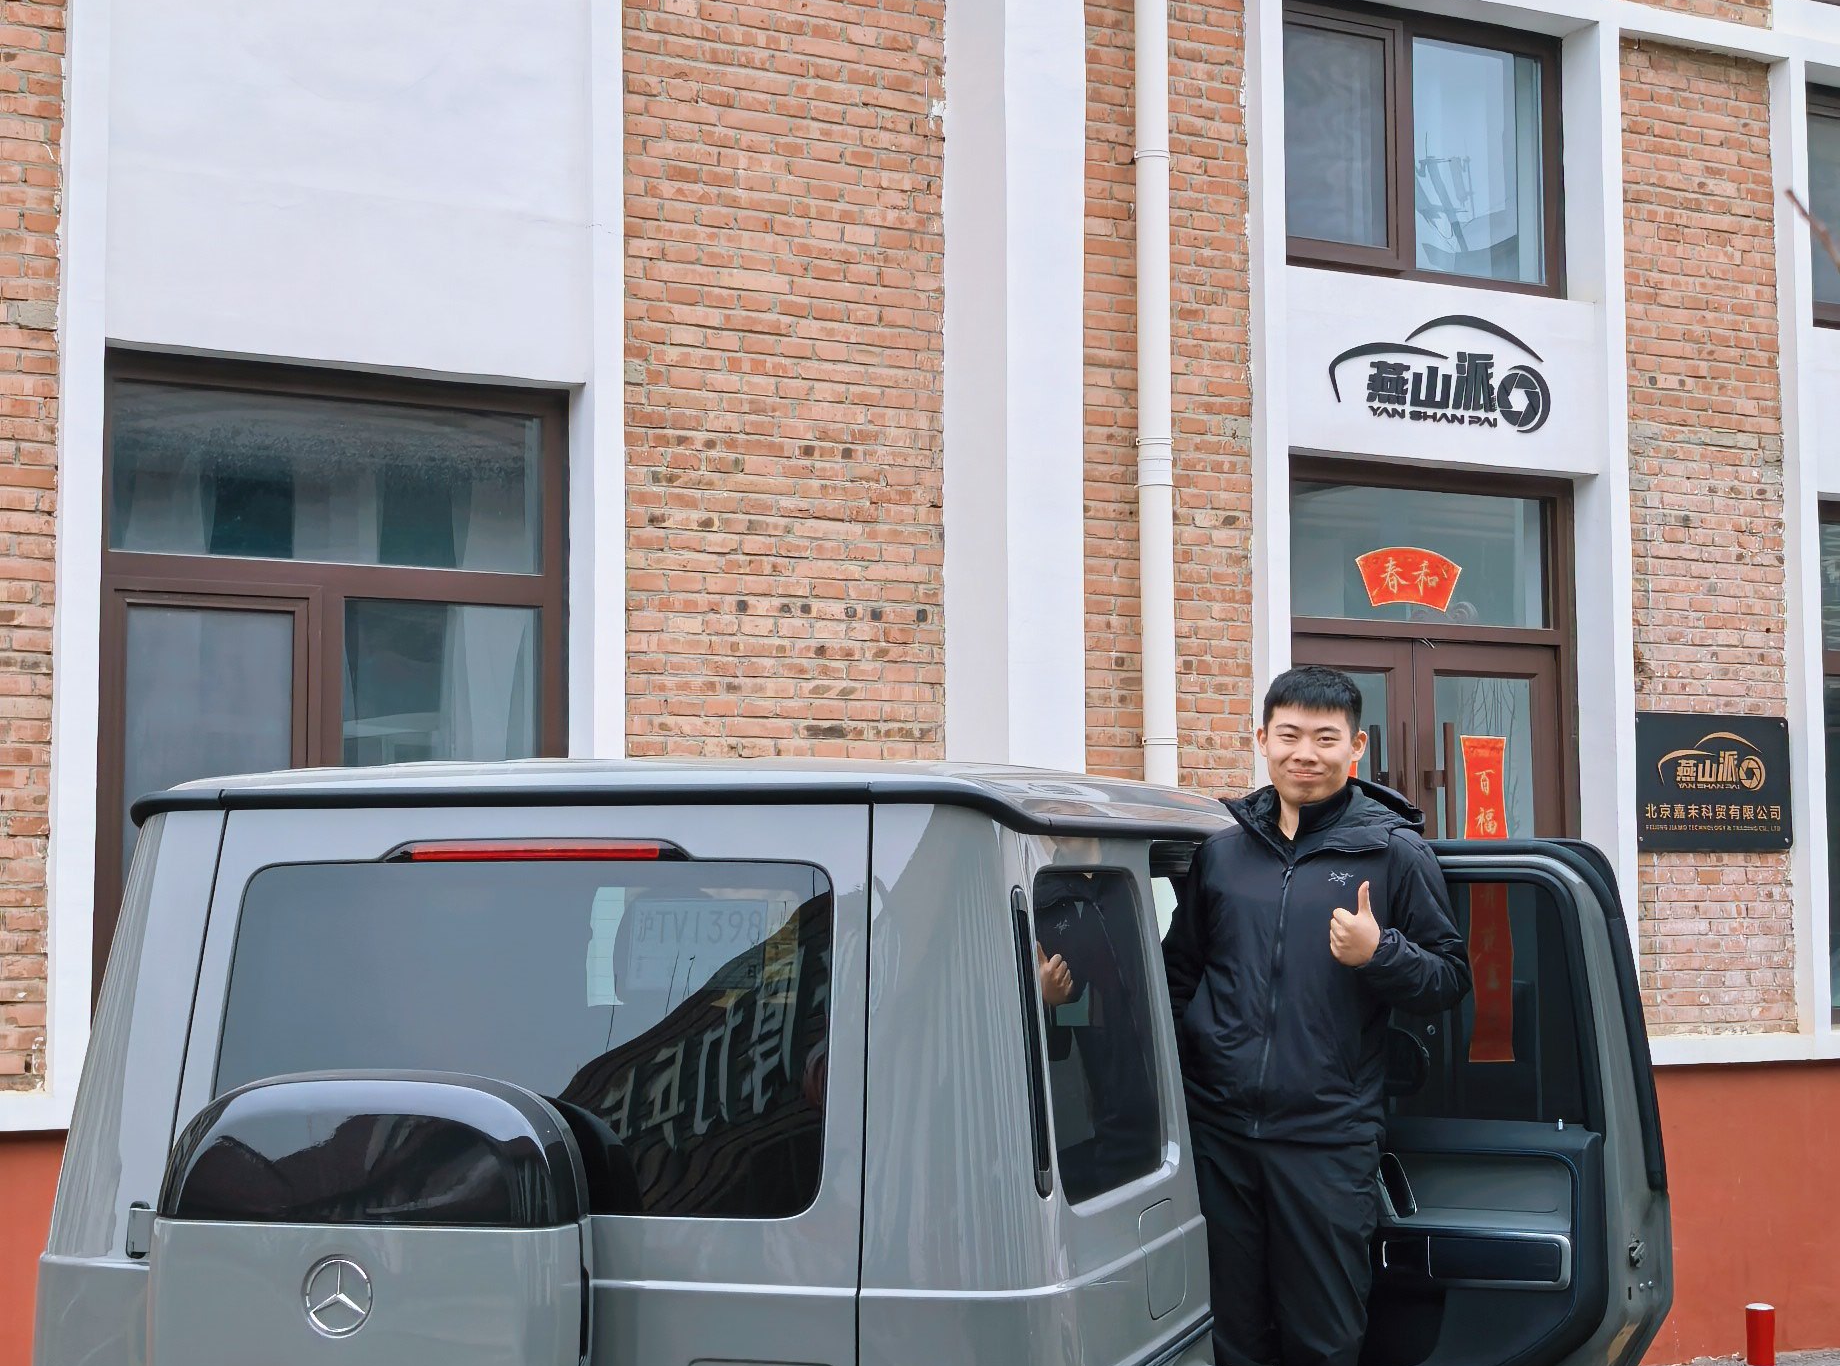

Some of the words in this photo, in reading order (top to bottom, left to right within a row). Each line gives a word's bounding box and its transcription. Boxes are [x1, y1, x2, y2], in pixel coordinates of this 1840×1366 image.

[1366, 351, 1496, 413] 燕山派
[1368, 405, 1406, 419] YAN
[1409, 410, 1465, 425] SHAN
[1468, 415, 1498, 429] PAI
[1373, 556, 1440, 596] 春和
[1676, 750, 1738, 782] 燕山派
